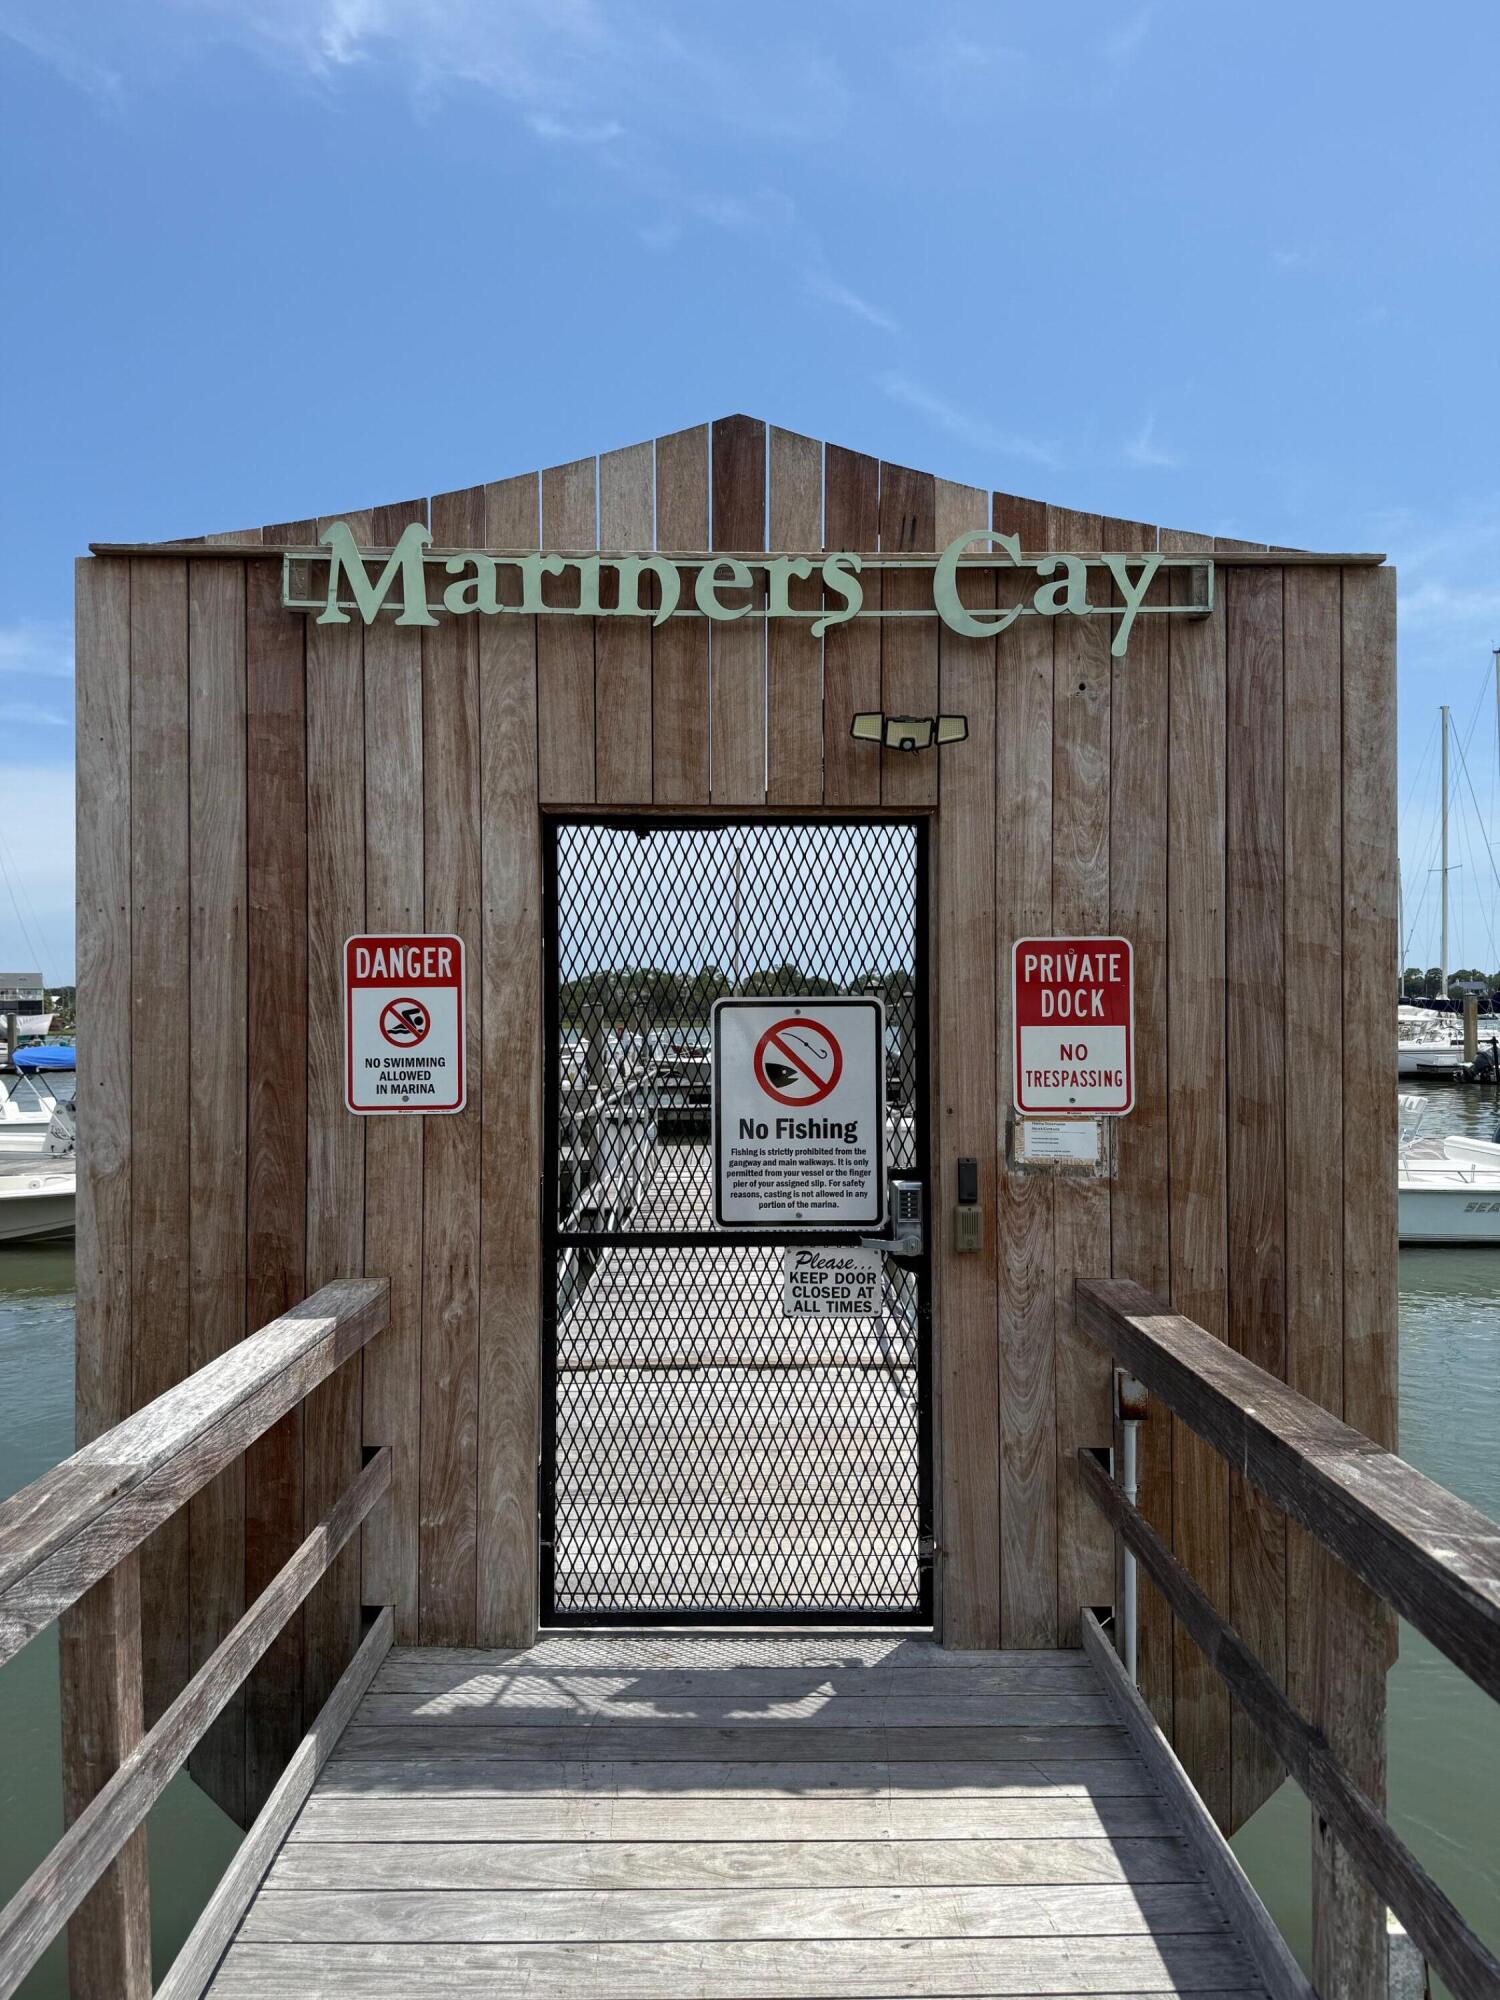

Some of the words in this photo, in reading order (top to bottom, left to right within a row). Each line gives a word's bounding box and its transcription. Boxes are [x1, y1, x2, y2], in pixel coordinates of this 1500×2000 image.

[315, 521, 864, 638] Mariners
[933, 529, 1164, 656] Cay
[356, 947, 452, 978] DANGER
[1025, 954, 1121, 983] PRIVATE
[1041, 989, 1105, 1018] DOCK
[1060, 1044, 1088, 1061] NO
[365, 1058, 380, 1068] NO
[384, 1057, 446, 1067] SWIMMING
[380, 1071, 431, 1081] ALLOWED
[1026, 1070, 1123, 1087] TRESPASSING
[376, 1085, 389, 1094] IN
[391, 1084, 435, 1094] MARINA
[739, 1118, 768, 1140] No
[776, 1118, 858, 1143] Fishing
[731, 1148, 758, 1157] Fishing
[768, 1148, 794, 1157] strictly
[795, 1148, 833, 1156] prohibited
[799, 1159, 835, 1167] walkways.
[853, 1159, 869, 1167] only
[727, 1170, 763, 1178] permitted
[849, 1169, 871, 1178] finger
[733, 1180, 747, 1188] pier
[776, 1180, 809, 1188] assigned
[811, 1180, 827, 1188] slip.
[842, 1180, 865, 1188] safety
[764, 1191, 792, 1199] casting
[759, 1201, 785, 1209] portion
[795, 1251, 872, 1271] Please...
[789, 1273, 828, 1284] KEEP
[835, 1273, 876, 1284] DOOR
[792, 1287, 850, 1298] CLOSED
[857, 1287, 874, 1298] AT
[794, 1301, 820, 1312] ALL
[826, 1301, 872, 1312] TIMES
